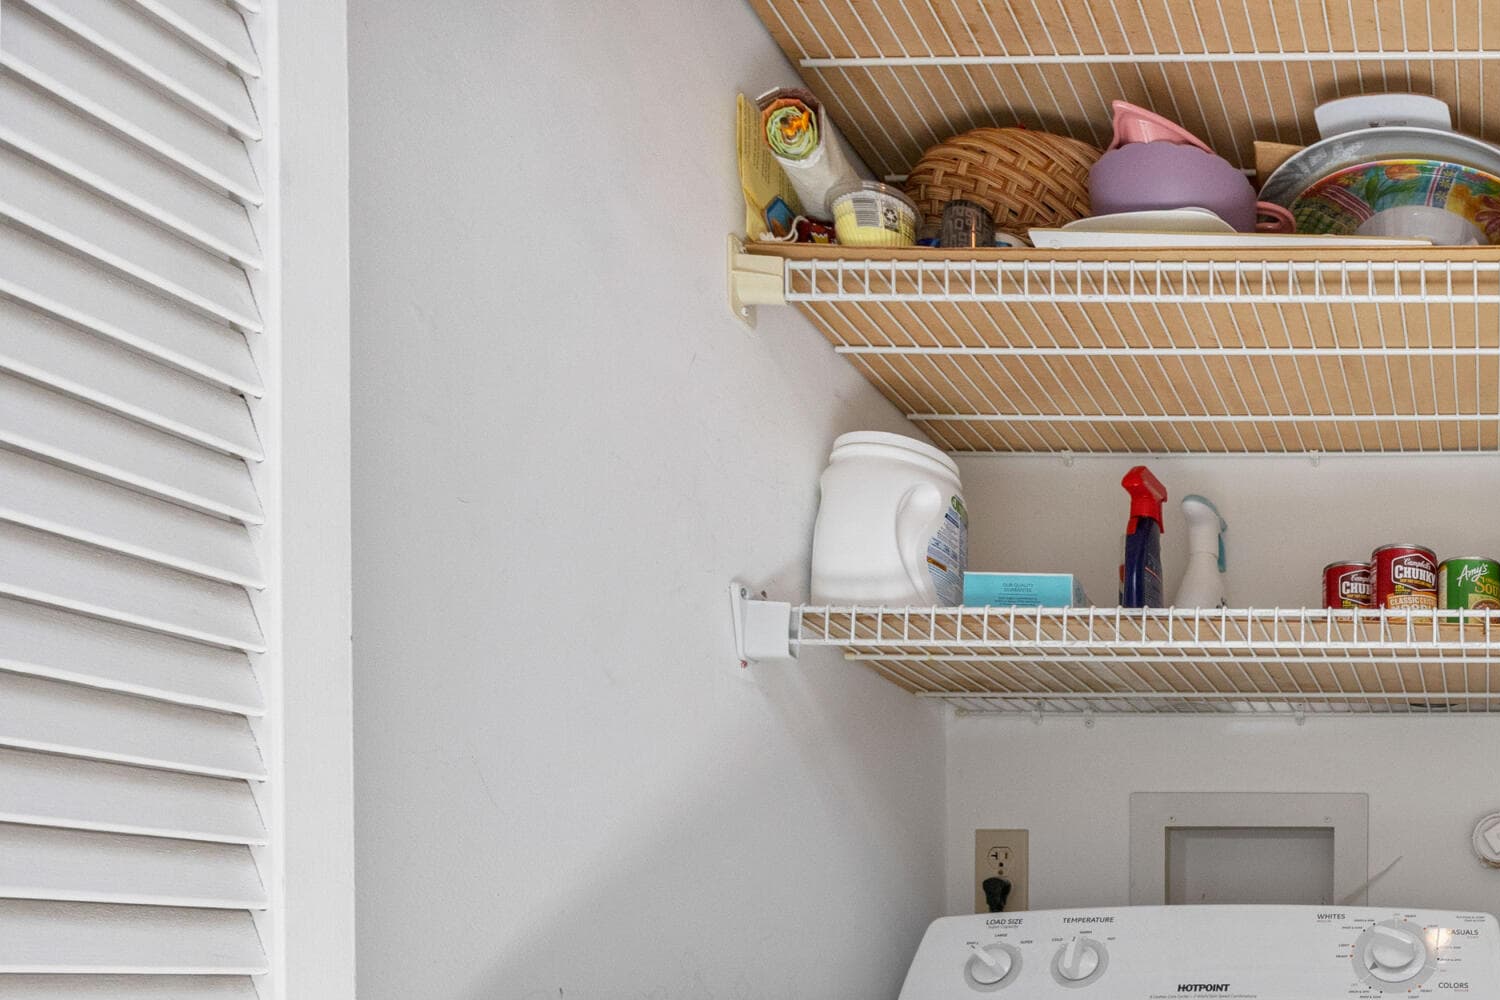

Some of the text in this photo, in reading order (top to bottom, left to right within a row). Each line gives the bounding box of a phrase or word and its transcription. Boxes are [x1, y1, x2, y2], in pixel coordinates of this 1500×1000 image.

[1394, 564, 1437, 587] CHUNKY
[1456, 563, 1489, 588] Amy's
[986, 918, 1006, 926] LOAD
[1063, 916, 1115, 924] TEMPERATURE
[1449, 928, 1480, 936] ASUALS
[1177, 983, 1231, 992] HOTPOINT
